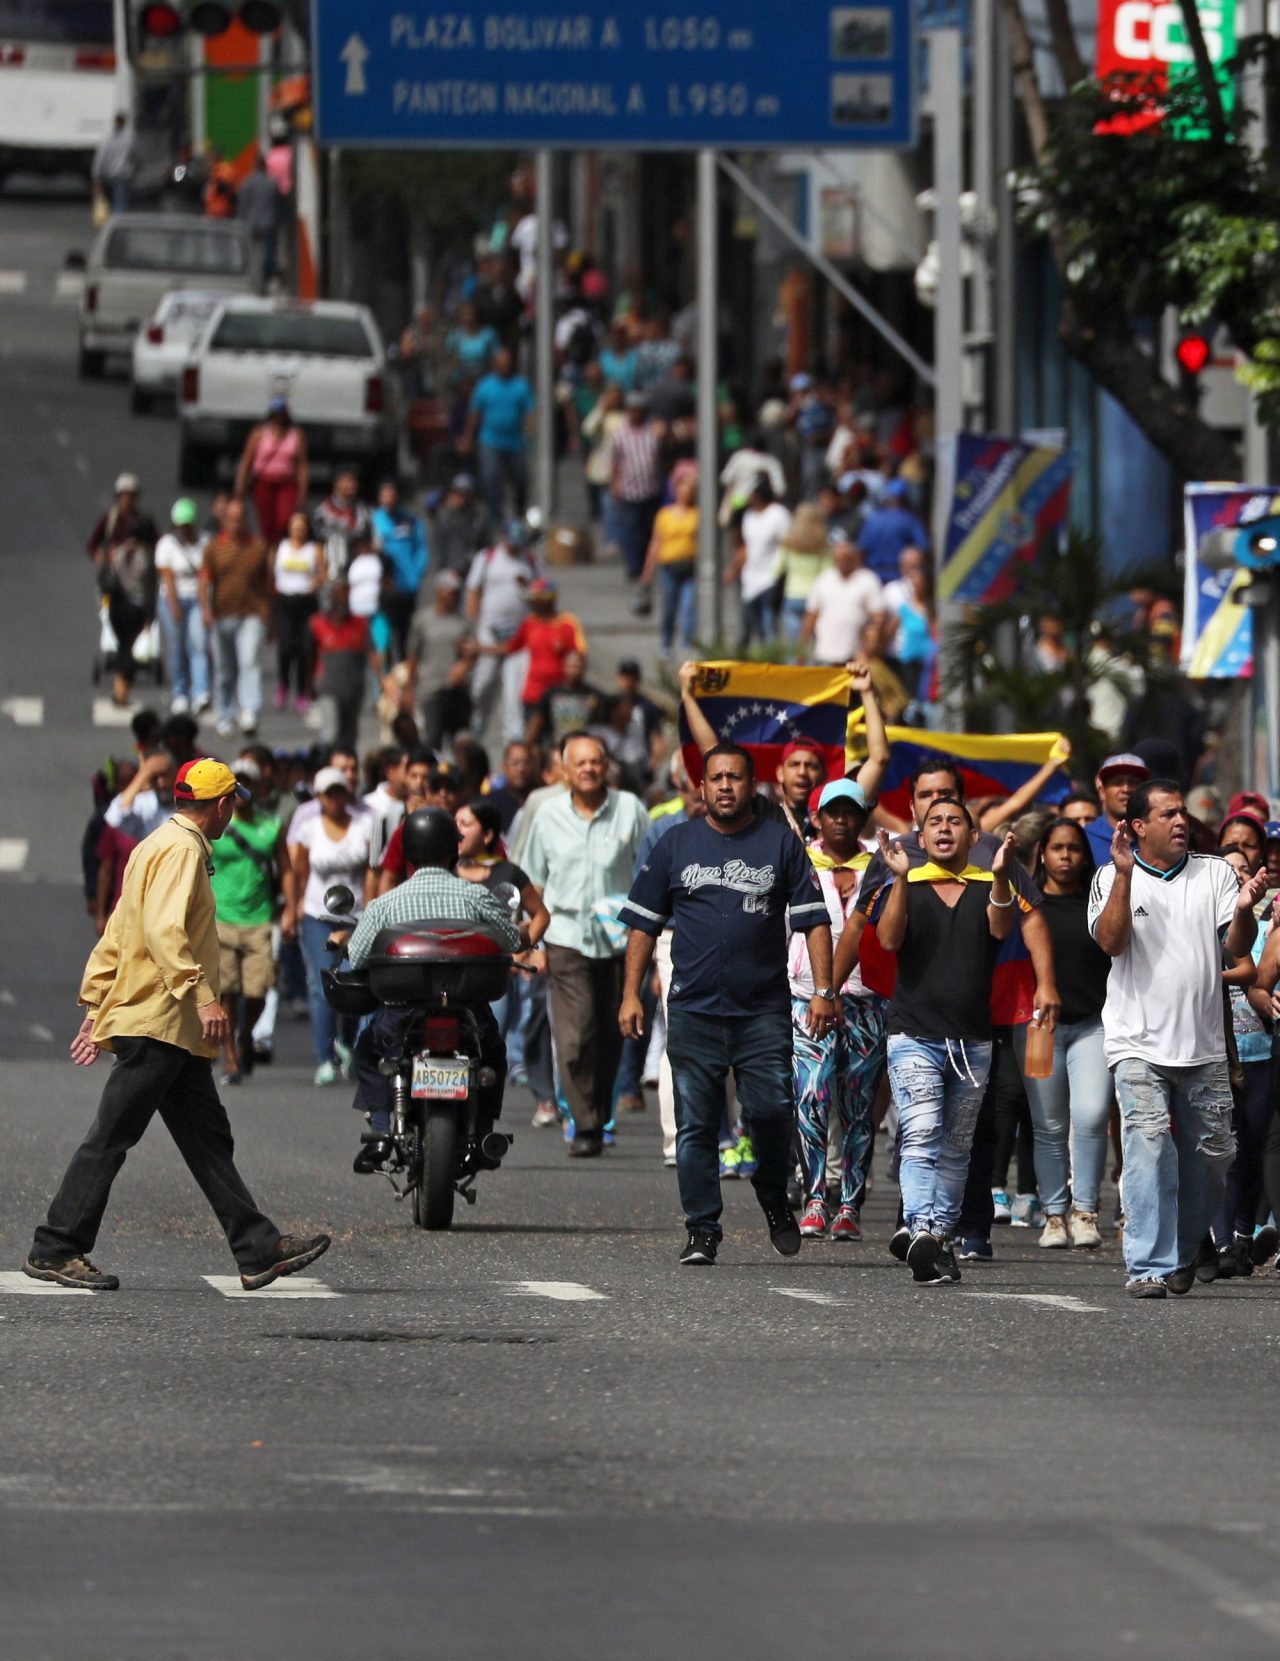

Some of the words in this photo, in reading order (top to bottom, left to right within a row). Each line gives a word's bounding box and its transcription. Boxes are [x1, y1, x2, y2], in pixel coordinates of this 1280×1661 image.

[390, 14, 475, 48] PLAZA
[602, 16, 621, 49] A
[728, 28, 752, 49] m
[504, 81, 618, 116] NACIONAL
[626, 82, 646, 116] A
[754, 95, 780, 117] m
[681, 863, 721, 889] New
[723, 859, 775, 889] York
